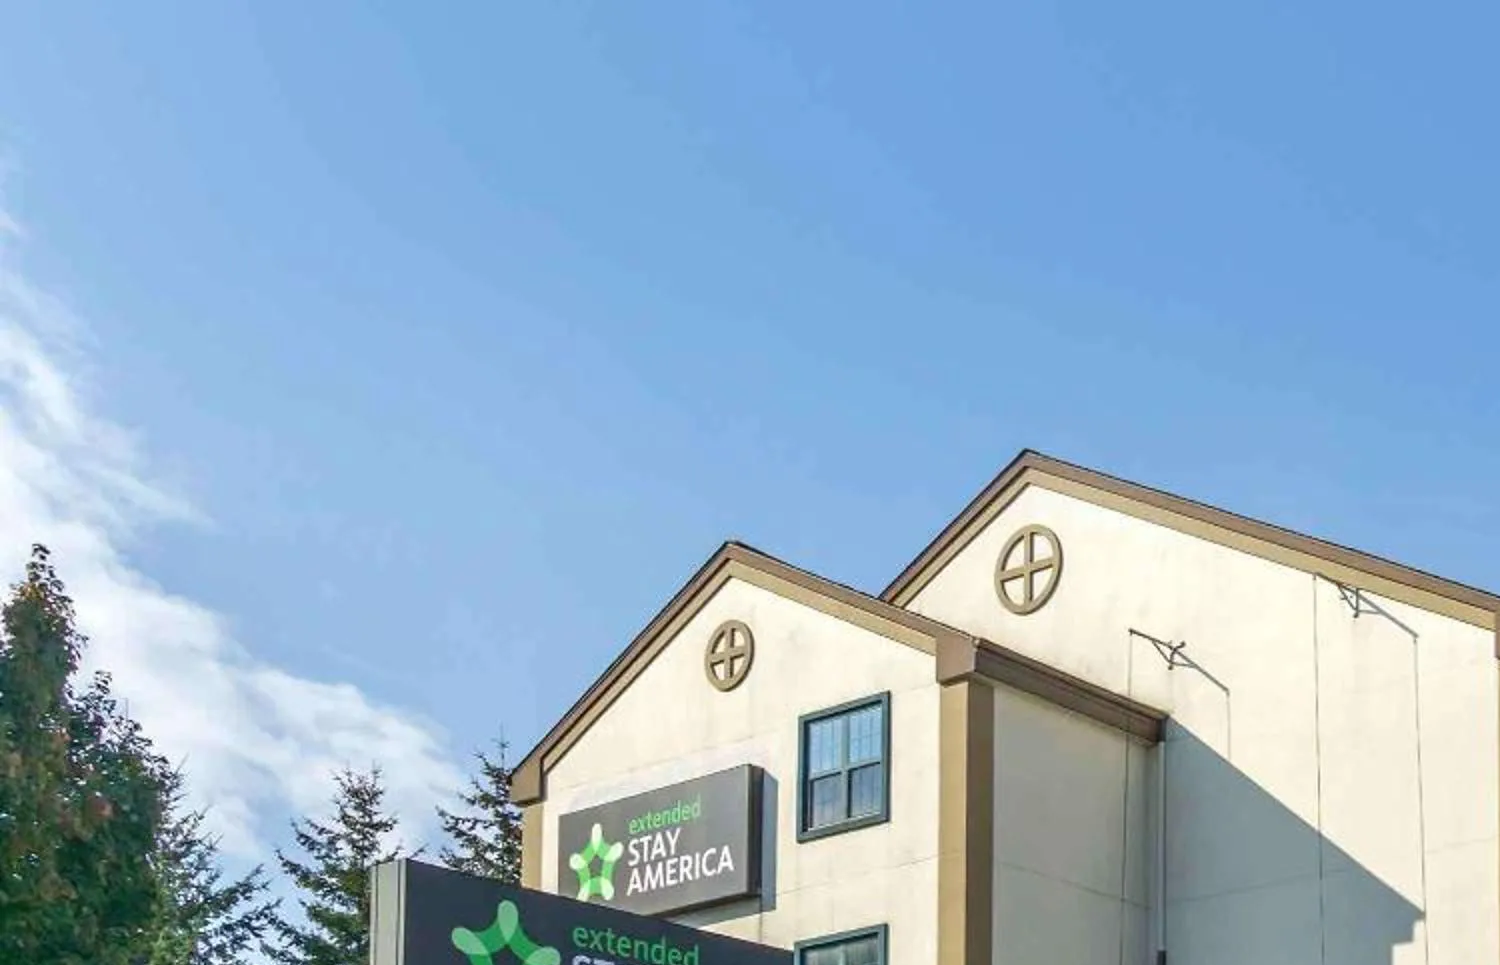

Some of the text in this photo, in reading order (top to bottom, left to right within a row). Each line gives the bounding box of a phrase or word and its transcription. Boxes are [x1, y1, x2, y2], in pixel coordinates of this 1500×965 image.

[628, 793, 702, 835] extended
[627, 827, 682, 867] STAY
[626, 845, 735, 896] AMERICA
